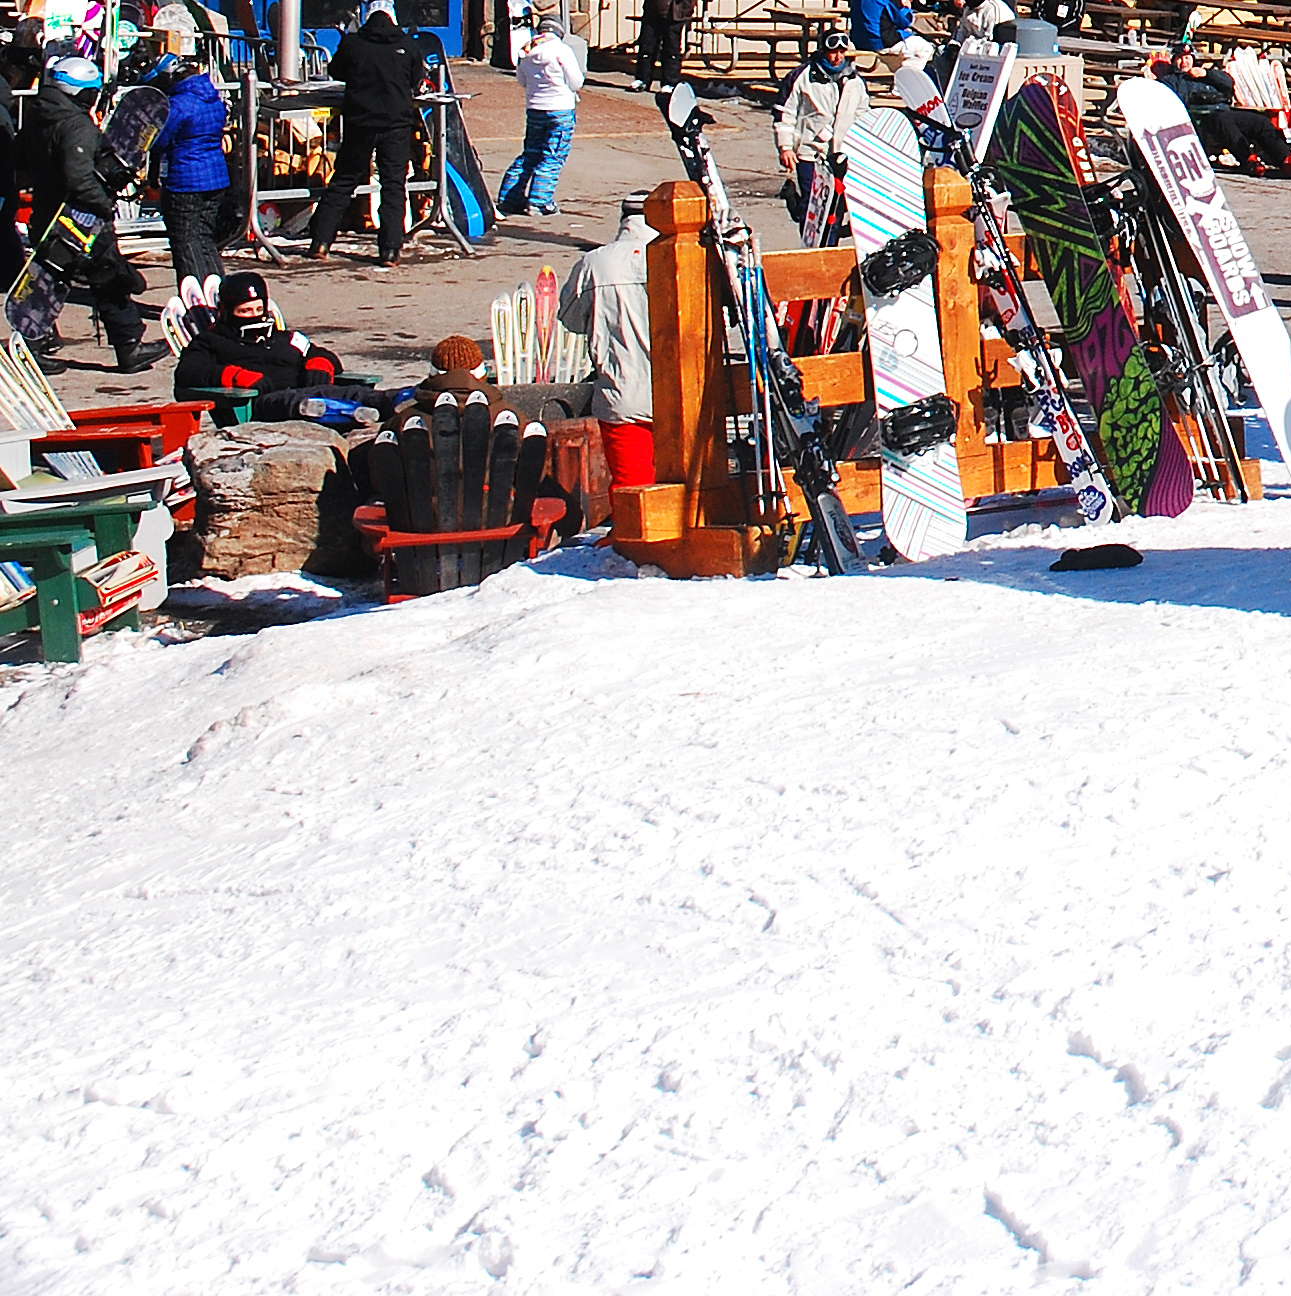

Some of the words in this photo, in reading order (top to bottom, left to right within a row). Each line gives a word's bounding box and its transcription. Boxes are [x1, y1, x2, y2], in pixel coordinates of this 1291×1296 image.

[959, 71, 970, 81] Ice
[971, 71, 995, 84] Cream
[1072, 136, 1095, 182] HEAD
[1204, 217, 1251, 307] BOARDS
[1220, 214, 1259, 278] SNOW
